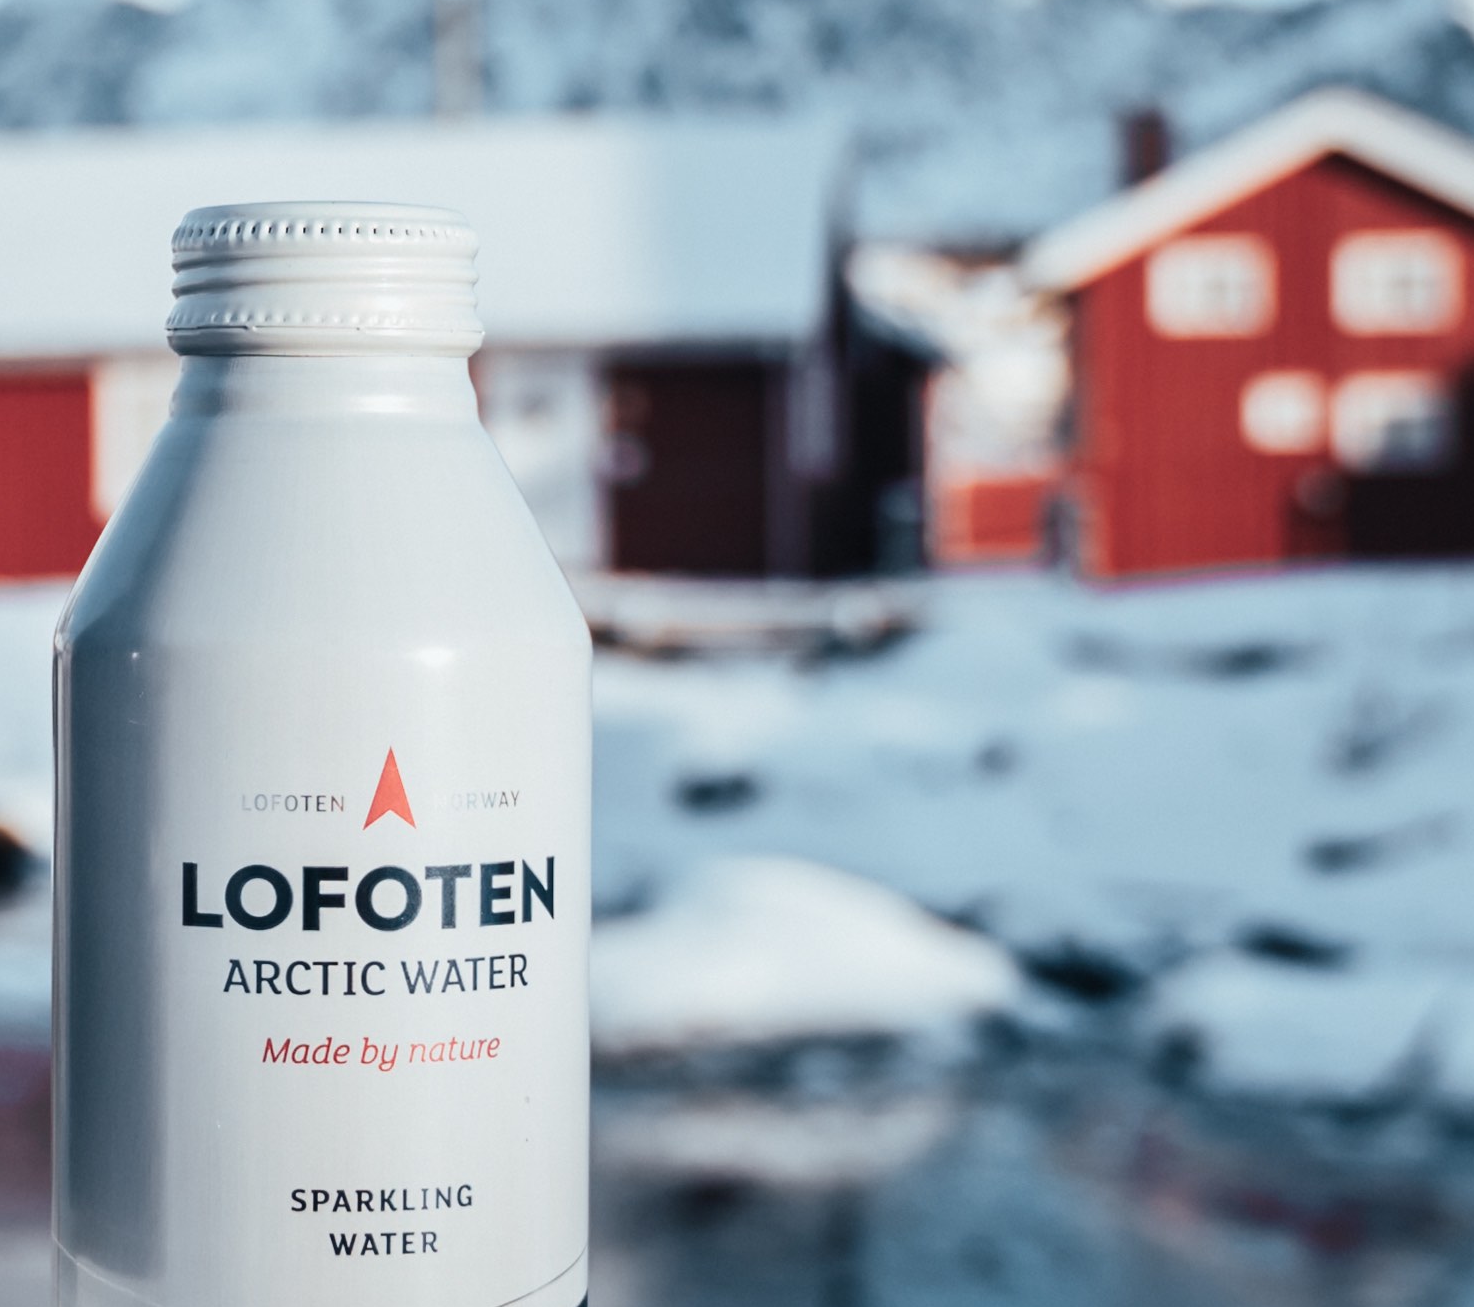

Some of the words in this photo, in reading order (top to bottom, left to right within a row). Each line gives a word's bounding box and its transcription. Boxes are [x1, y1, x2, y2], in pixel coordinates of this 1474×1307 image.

[241, 794, 345, 813] LOFOTEN
[438, 790, 520, 812] ORWAY
[182, 855, 555, 932] LOFOTEN
[223, 958, 386, 996] ARCTIC
[401, 953, 529, 993] WATER
[262, 1037, 351, 1065] Made
[360, 1037, 398, 1072] by
[409, 1036, 500, 1063] nature
[290, 1184, 473, 1212] SPARKLING
[329, 1231, 438, 1256] WATER
